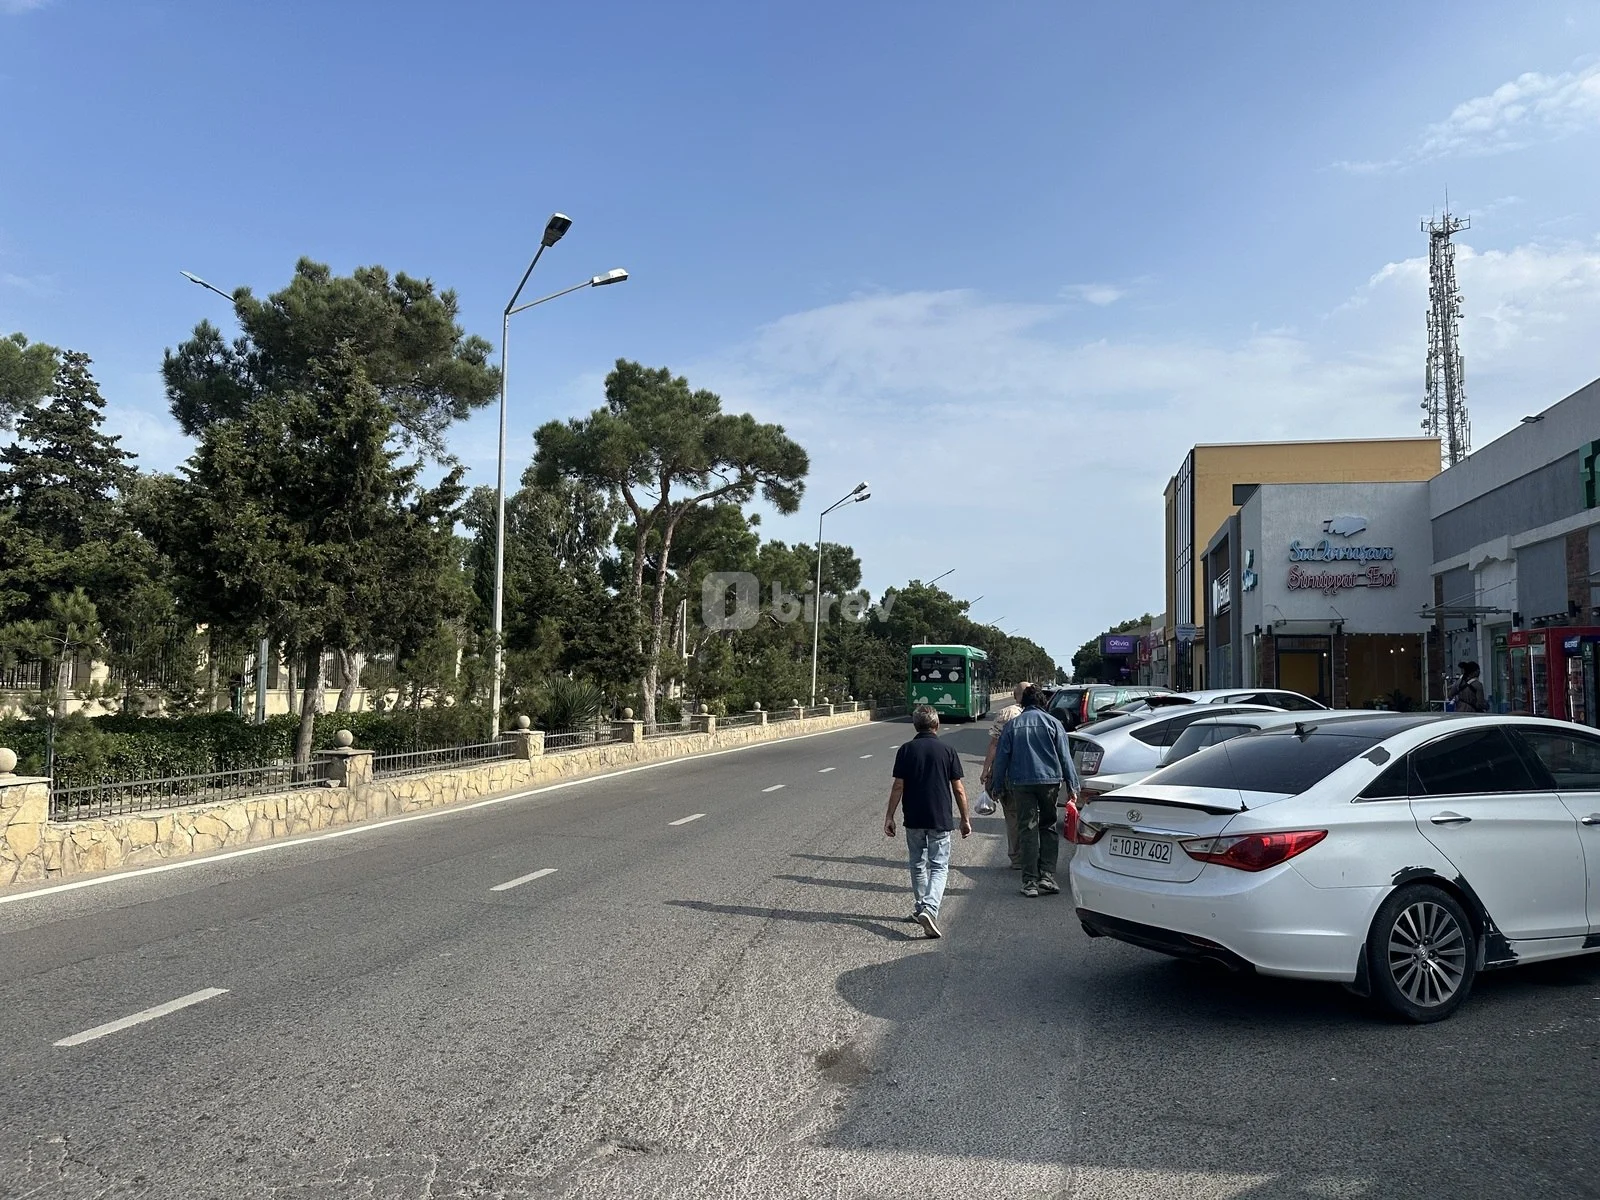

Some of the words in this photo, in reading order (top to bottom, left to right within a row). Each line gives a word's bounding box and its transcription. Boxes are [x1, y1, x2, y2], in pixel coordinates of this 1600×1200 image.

[1365, 565, 1398, 588] Evi
[1120, 839, 1132, 855] 10
[1132, 841, 1147, 857] BY
[1148, 843, 1170, 861] 402
